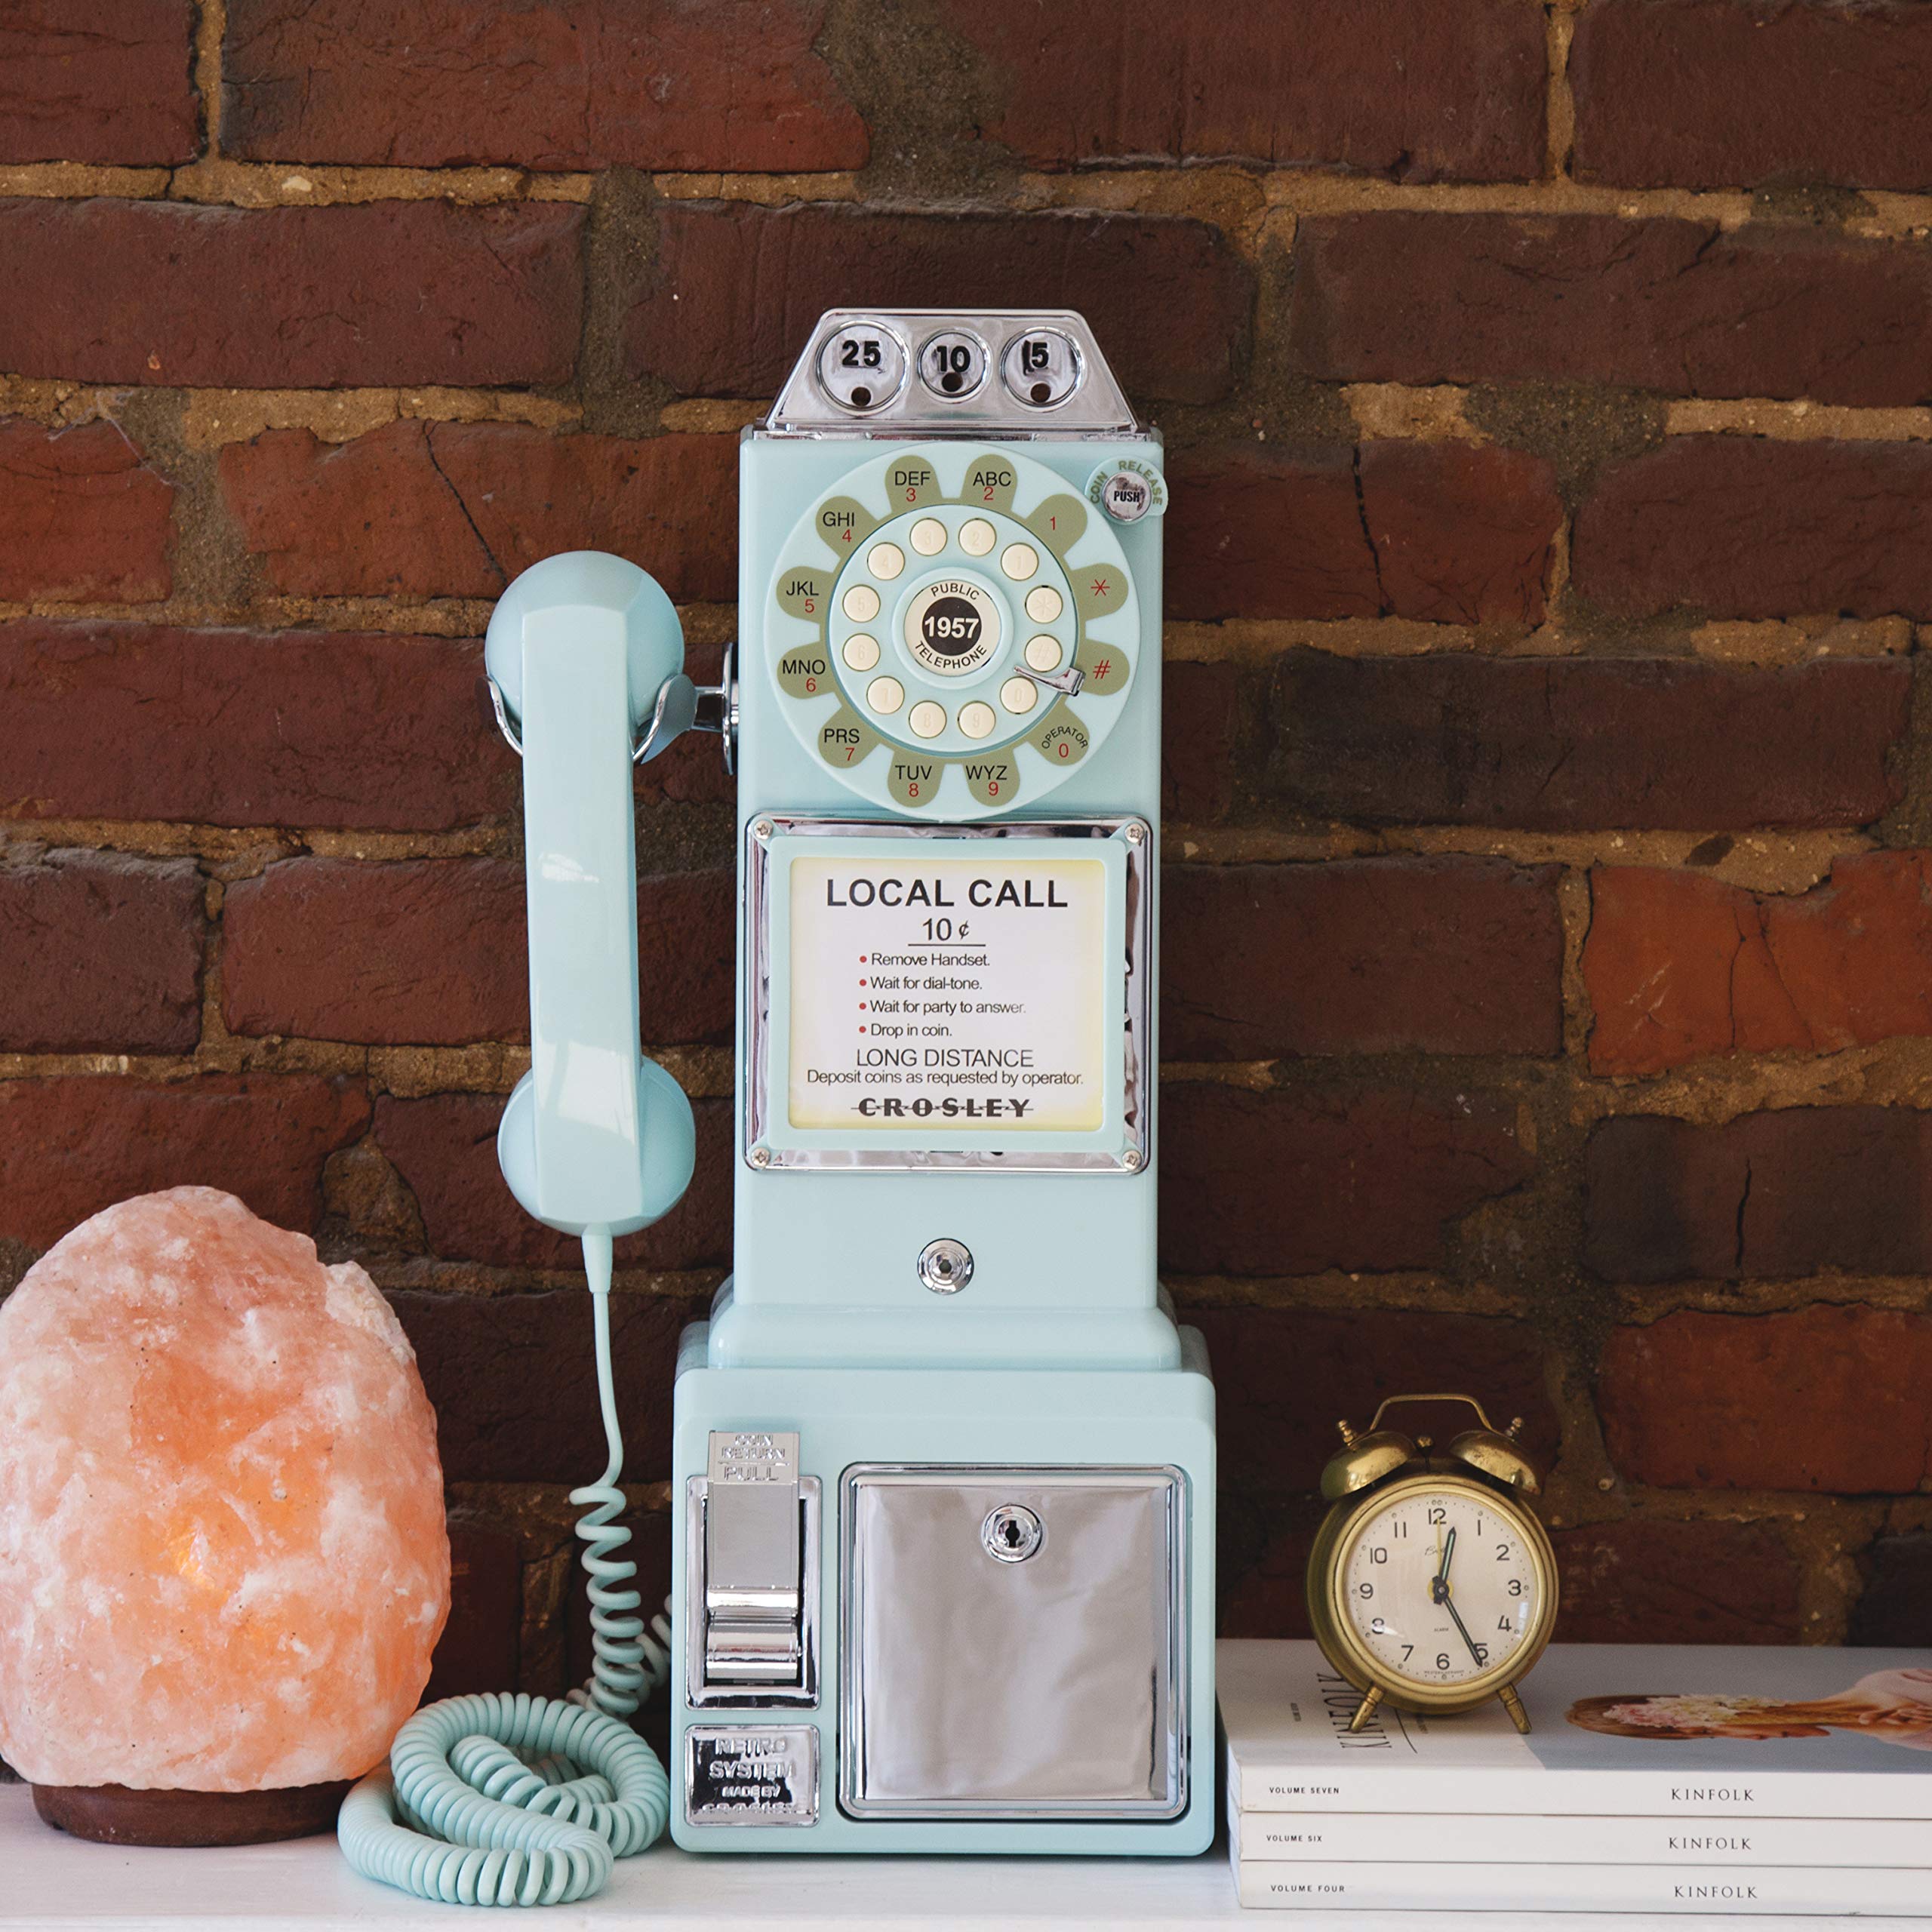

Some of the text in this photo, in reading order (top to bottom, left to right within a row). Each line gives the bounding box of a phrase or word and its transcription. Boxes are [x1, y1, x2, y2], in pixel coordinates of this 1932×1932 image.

[841, 340, 881, 367] 25
[937, 345, 971, 372] 10
[894, 471, 931, 485] DEF
[973, 472, 1011, 486] ABC
[1091, 460, 1163, 505] COIN RELEASE
[906, 488, 916, 502] 3
[984, 487, 994, 500] 2
[1114, 491, 1140, 503] PUSH
[823, 512, 855, 527] GHI
[1050, 516, 1056, 531] 1
[841, 529, 852, 543] 4
[786, 581, 819, 595] JKL
[931, 583, 980, 601] PUBLIC
[804, 599, 815, 614] 5
[924, 616, 980, 638] 1957
[915, 640, 987, 669] TELEPHONE
[783, 660, 826, 675] MNO
[1093, 660, 1111, 679] #
[806, 678, 817, 693] 6
[824, 728, 860, 743] PRS
[1041, 726, 1088, 749] OPERATOR
[845, 747, 855, 761] 7
[1058, 743, 1069, 758] 0
[895, 765, 932, 780] TUV
[966, 765, 1008, 780] WYZ
[909, 783, 918, 797] 8
[988, 782, 998, 796] 9
[827, 878, 1068, 908] LOCAL CALL
[922, 918, 952, 941] 10
[872, 953, 990, 966] Remove Handset.
[870, 977, 983, 989] Wait for dial-tone.
[870, 1000, 1026, 1016] Wait for party to answer.
[871, 1024, 952, 1039] Drop in coin.
[857, 1049, 1034, 1067] LONG DISTANCE
[808, 1069, 1084, 1087] Deposit coins as requested by operator.
[858, 1097, 1030, 1118] CROSLEY
[724, 1466, 779, 1481] PULL
[1428, 1508, 1447, 1524] 12
[1394, 1521, 1407, 1538] 11
[1477, 1519, 1481, 1536] 1
[1370, 1547, 1387, 1564] 10
[1496, 1544, 1510, 1561] 2
[1359, 1583, 1374, 1599] 9
[1508, 1580, 1521, 1596] 3
[1371, 1617, 1385, 1635] 8
[1497, 1615, 1512, 1632] 4
[1401, 1644, 1414, 1662] 7
[1472, 1643, 1488, 1660] 5
[1436, 1653, 1450, 1670] 6
[715, 1737, 787, 1755] RETRO
[709, 1761, 796, 1780] SYSTEM
[721, 1786, 780, 1797] MADE BY
[1671, 1789, 1755, 1801] KINFOLK
[1669, 1837, 1752, 1850] KINFOLK
[1674, 1886, 1758, 1899] KINFOLK
